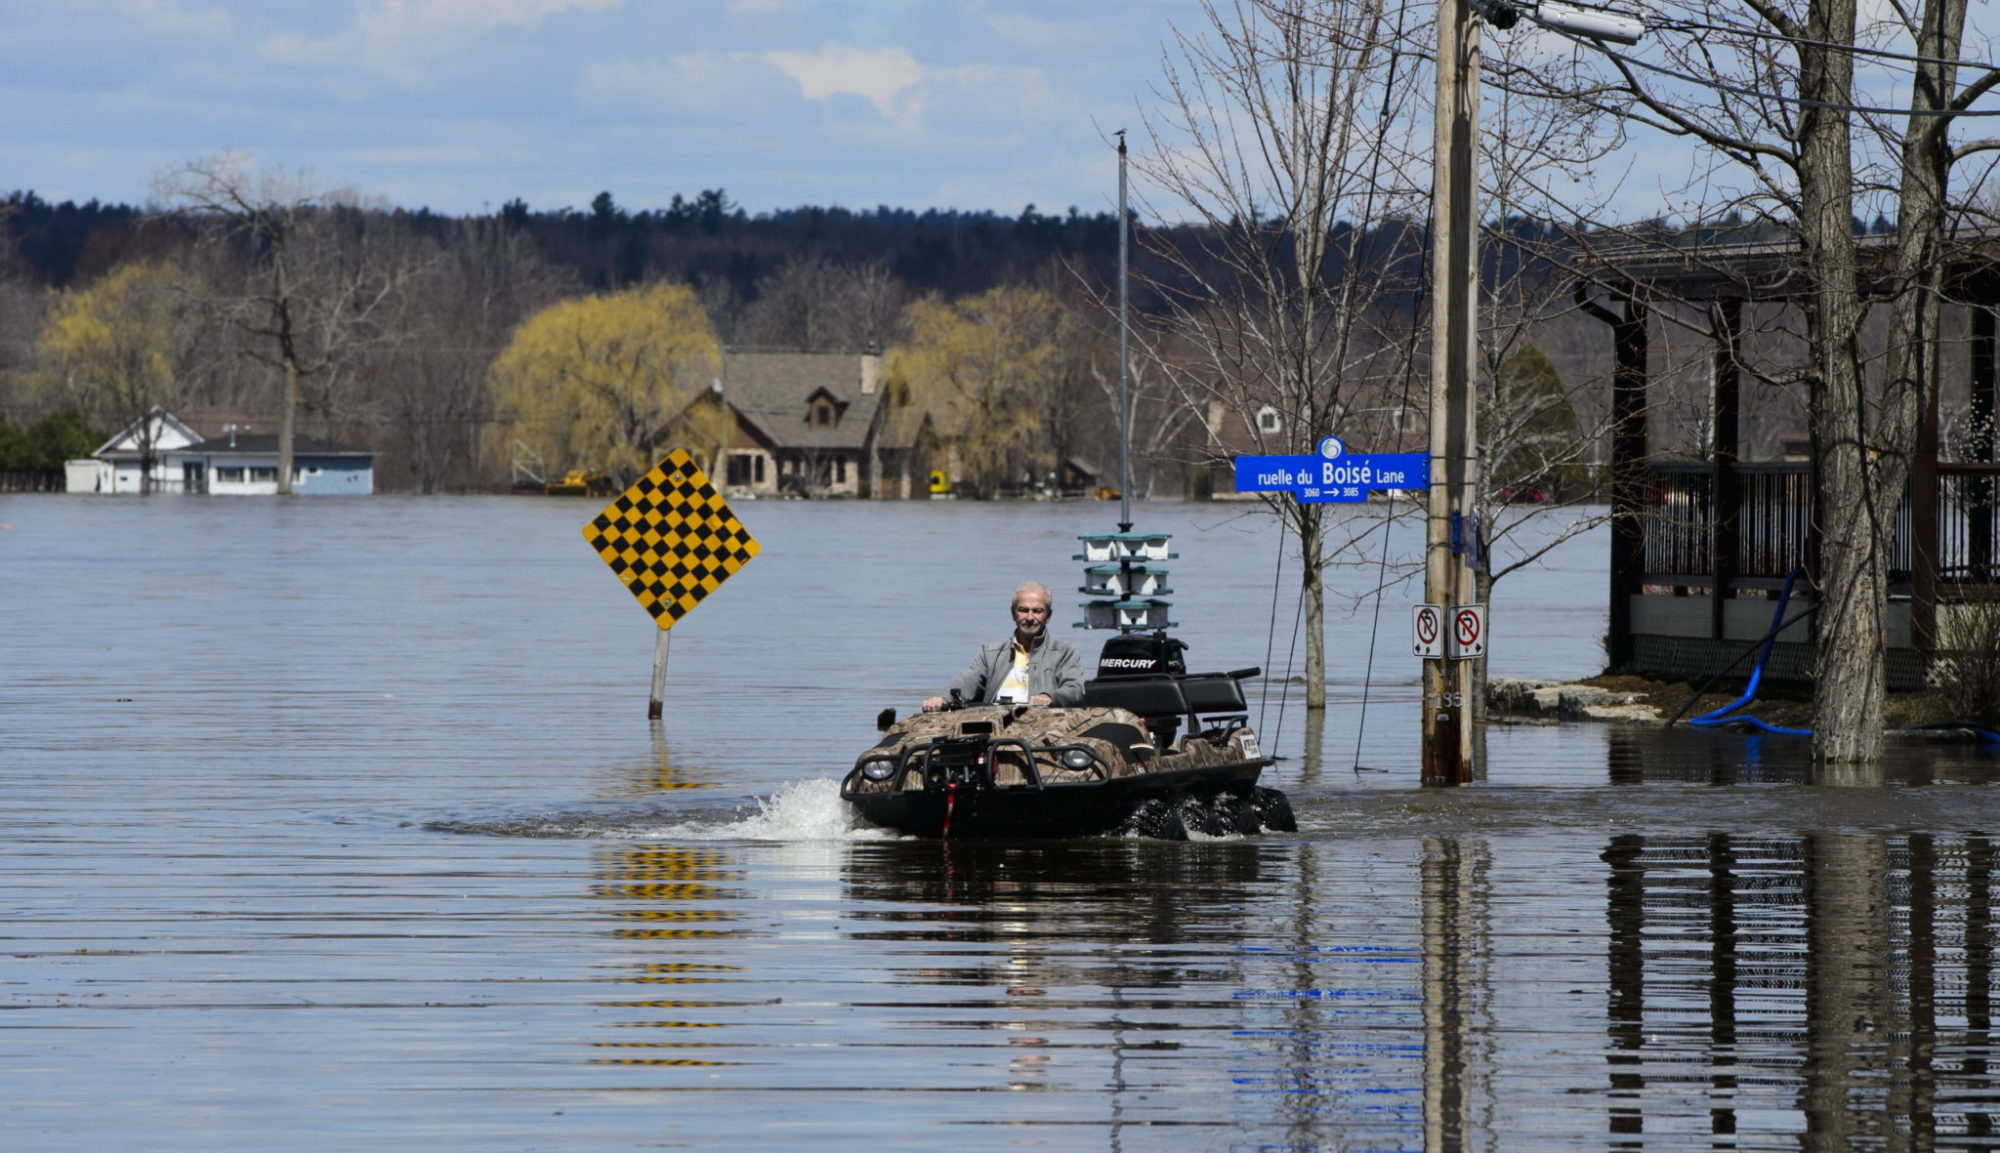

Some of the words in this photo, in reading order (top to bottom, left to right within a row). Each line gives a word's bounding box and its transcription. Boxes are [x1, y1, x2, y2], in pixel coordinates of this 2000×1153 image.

[1258, 469, 1292, 485] ruelle
[1297, 468, 1313, 485] du
[1322, 460, 1371, 485] Boisé
[1377, 469, 1404, 484] Lane
[1100, 659, 1156, 668] MERCURY
